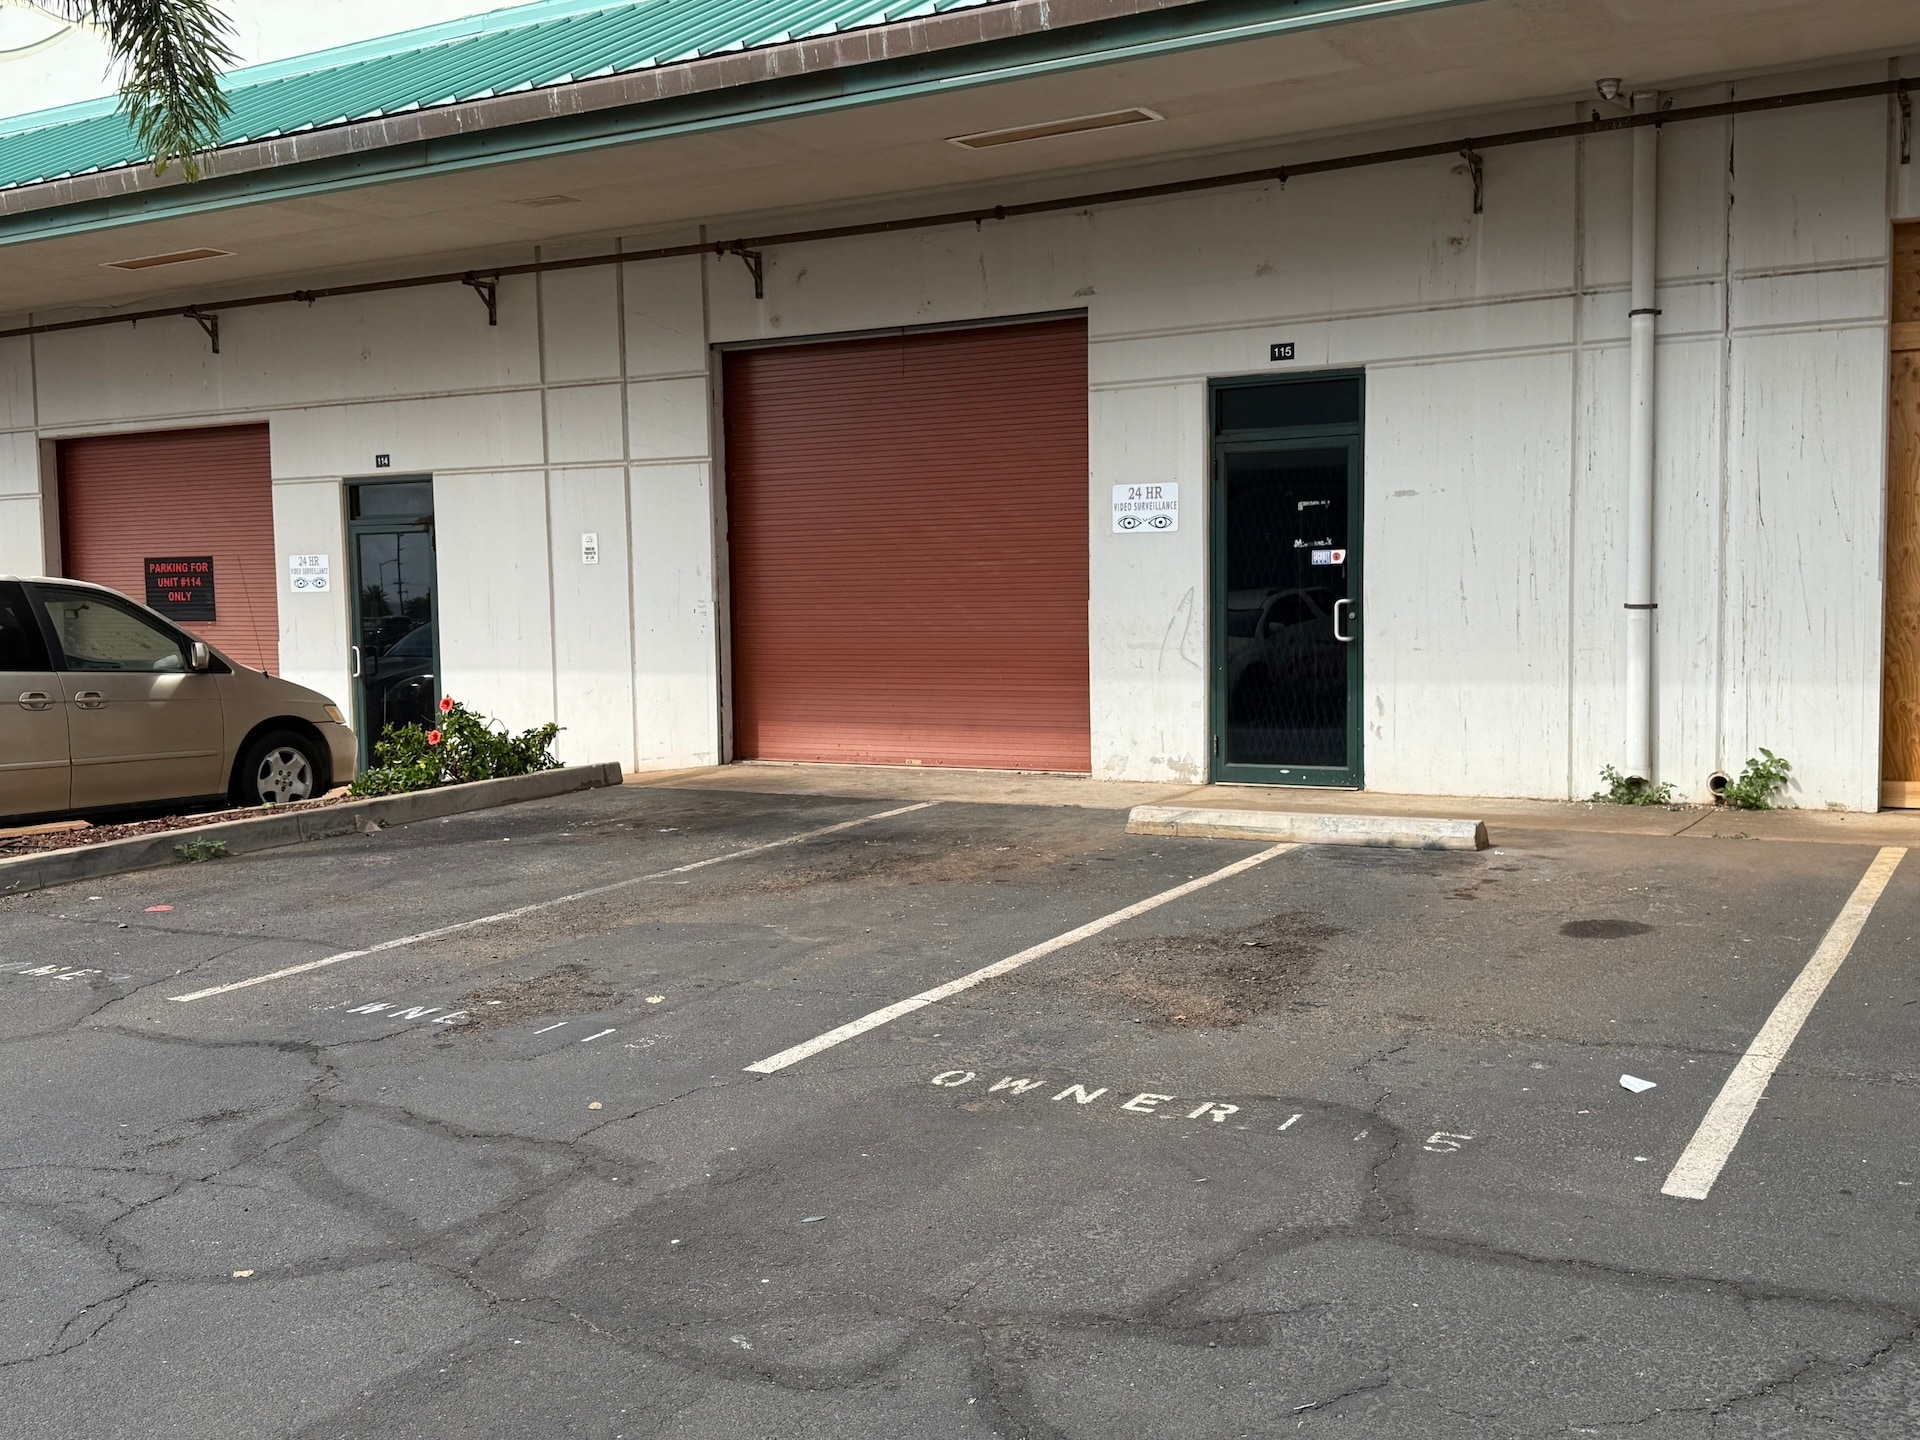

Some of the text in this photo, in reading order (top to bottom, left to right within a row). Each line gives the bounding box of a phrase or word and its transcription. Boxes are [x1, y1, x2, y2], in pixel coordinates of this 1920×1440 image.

[1273, 346, 1292, 358] 115
[377, 457, 389, 465] 114
[1128, 486, 1163, 500] 24 HR
[1113, 500, 1177, 512] VIDEO SURVEILLANCE
[298, 555, 320, 566] 24 HR
[149, 562, 209, 573] PARKING FOR
[157, 576, 202, 588] UNIT #114
[168, 591, 192, 602] ONLY
[930, 1069, 1240, 1123] OWNER
